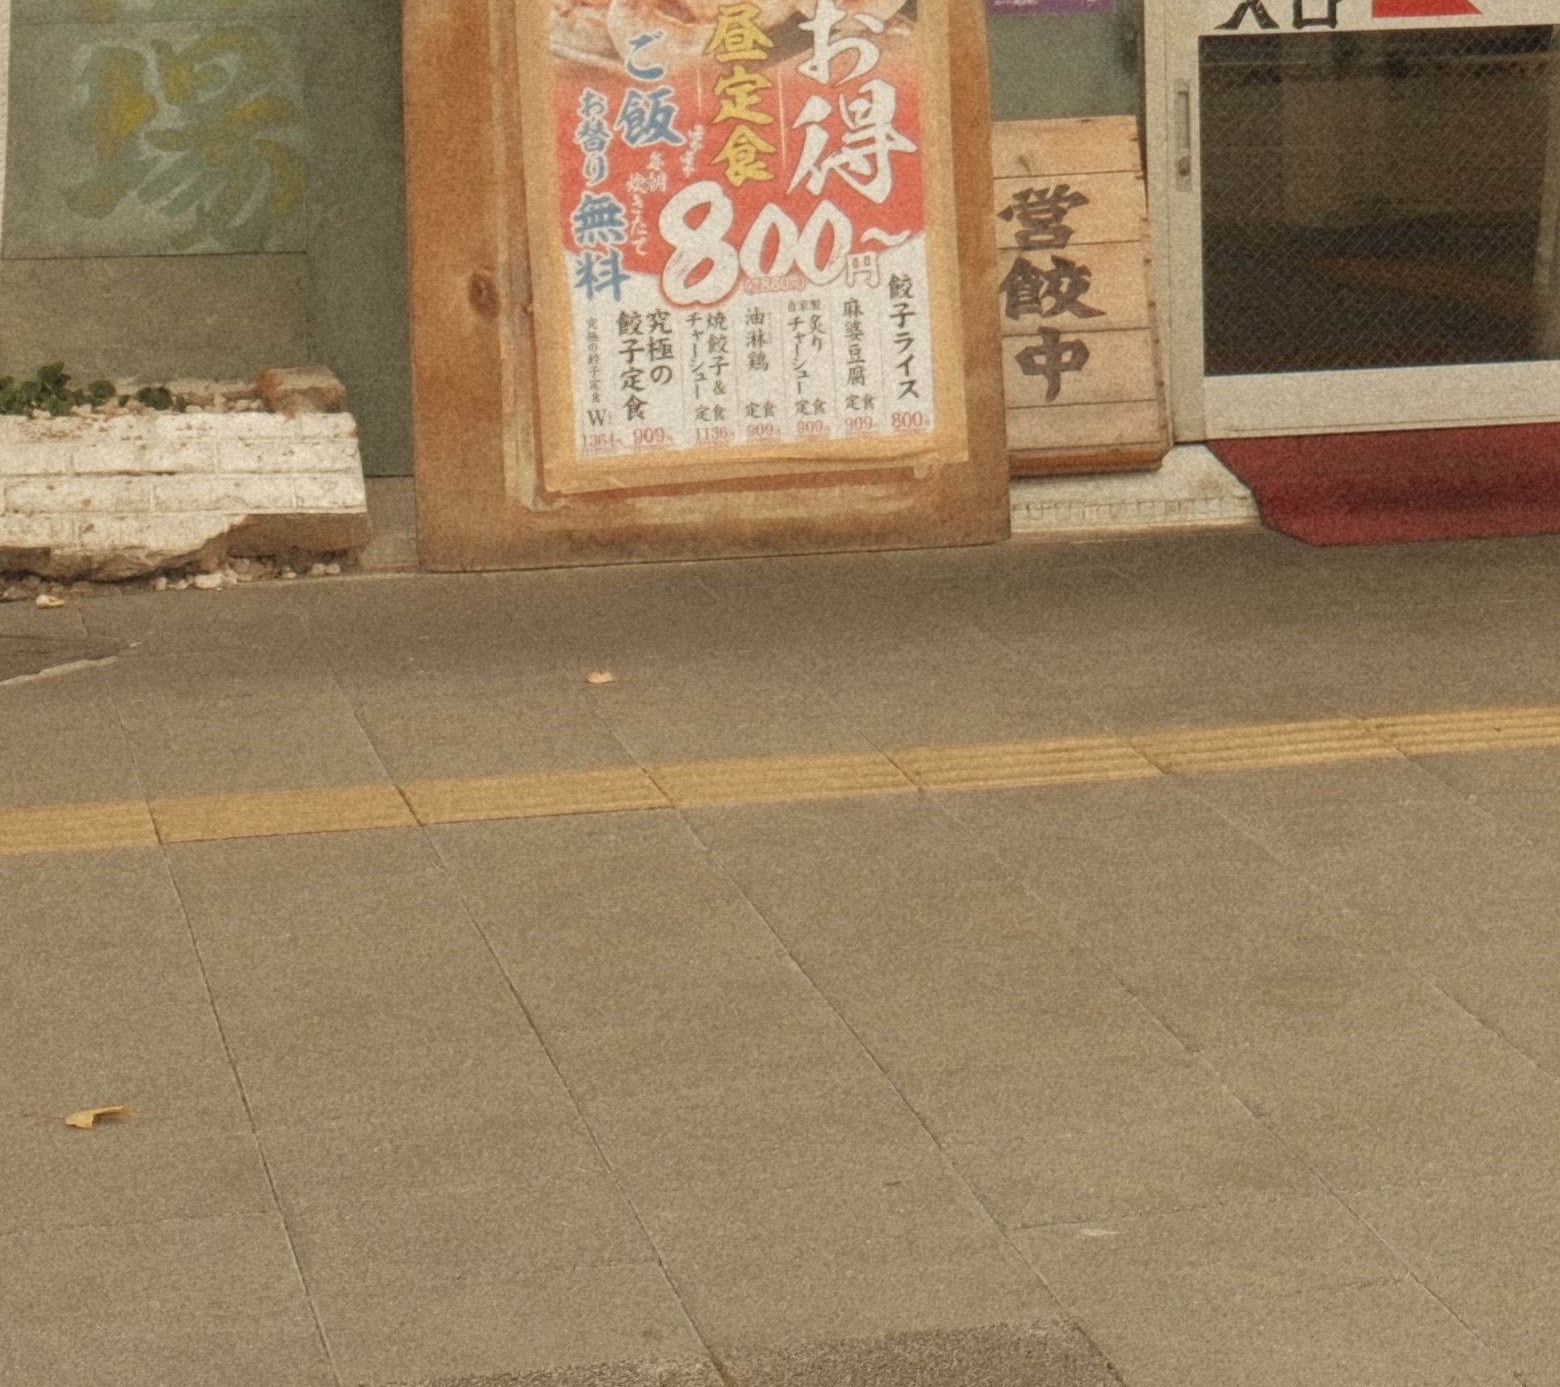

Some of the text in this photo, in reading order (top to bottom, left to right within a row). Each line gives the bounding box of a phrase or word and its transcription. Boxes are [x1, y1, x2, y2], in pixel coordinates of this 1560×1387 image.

[613, 29, 688, 148] ご飯
[706, 1, 777, 187] 昼定食
[574, 87, 613, 187] お替り
[571, 191, 632, 302] 無料
[889, 272, 920, 400] 餃子ライス
[999, 183, 1107, 405] 営餃中
[617, 309, 649, 422] 餃子定食
[646, 308, 674, 386] 究極の
[686, 311, 708, 400] チャーシュー
[744, 306, 769, 372] 油淋鶏
[788, 316, 810, 395] チャーシュー
[842, 297, 866, 387] 麻婆豆腐
[695, 403, 727, 422] 定食
[744, 400, 777, 419] 定食
[794, 397, 827, 416] 定食
[844, 393, 876, 411] 定食
